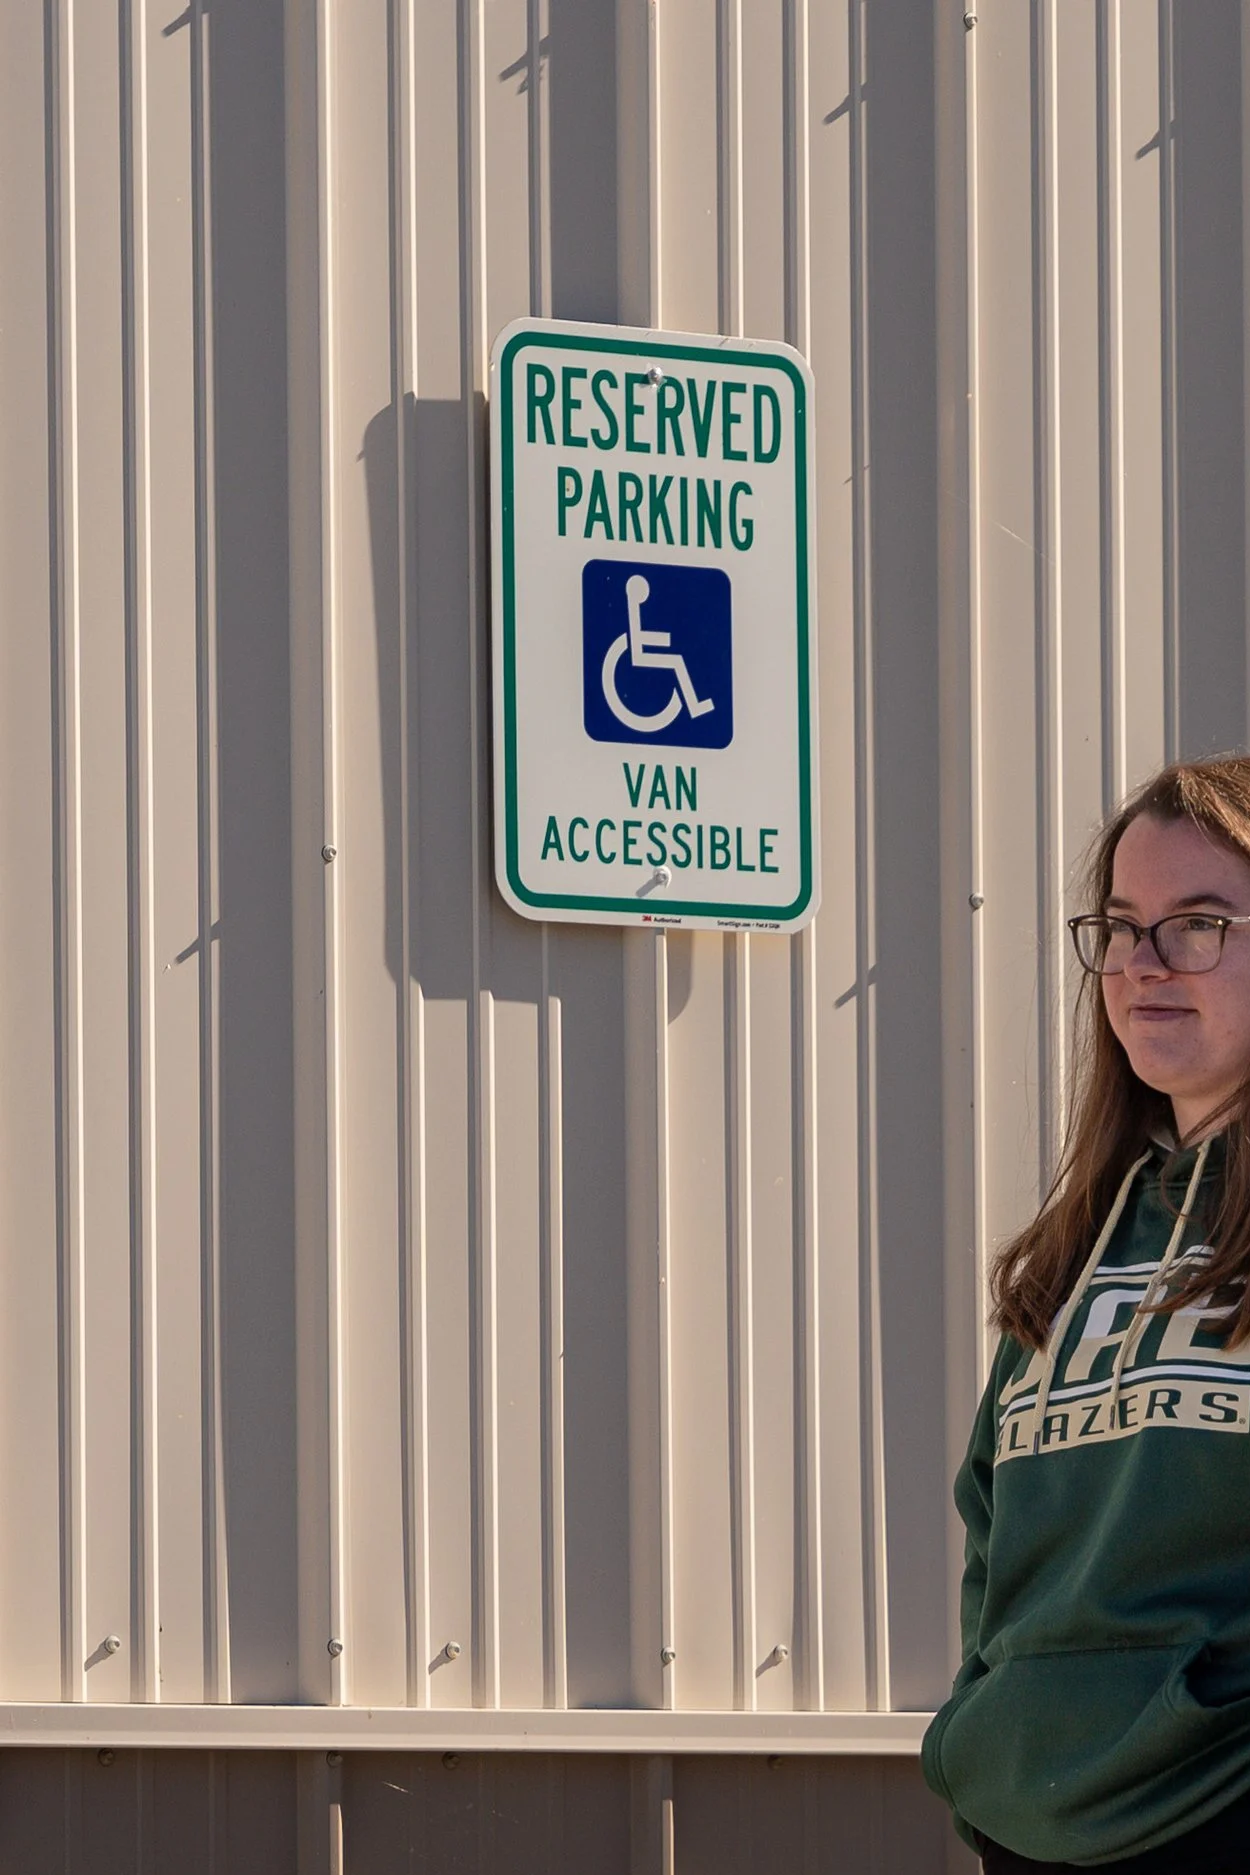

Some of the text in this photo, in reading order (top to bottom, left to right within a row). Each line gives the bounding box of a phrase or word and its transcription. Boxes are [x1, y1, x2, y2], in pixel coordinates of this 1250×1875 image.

[526, 363, 782, 464] RESERVED
[557, 466, 754, 552] PARKING
[623, 763, 697, 812] VAN
[540, 815, 778, 874] ACCESSIBLE
[998, 1388, 1241, 1453] LAZERS
